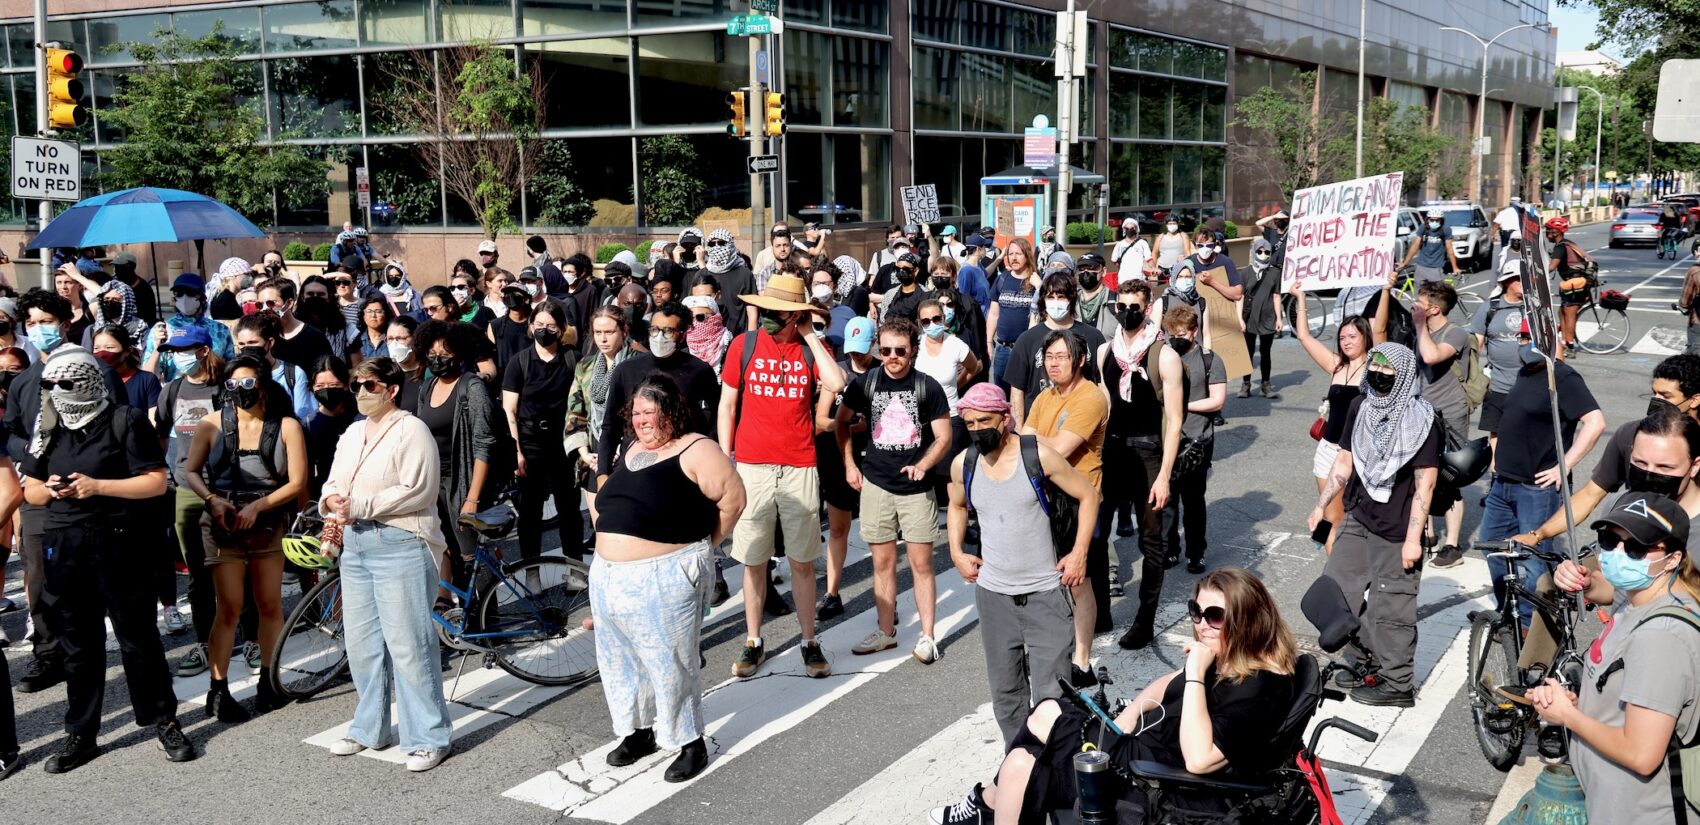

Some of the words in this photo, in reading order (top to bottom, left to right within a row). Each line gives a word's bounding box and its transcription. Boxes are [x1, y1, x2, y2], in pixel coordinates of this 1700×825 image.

[752, 0, 770, 10] ARCH
[746, 24, 768, 33] STREET
[36, 145, 58, 158] NO
[25, 160, 69, 175] TURN
[757, 160, 766, 168] ONE
[18, 176, 39, 189] ON
[45, 178, 76, 191] RED
[904, 185, 934, 199] END
[1292, 173, 1401, 219] IMMIGRANTS
[906, 198, 936, 211] ICE
[909, 209, 940, 225] RAIDS
[1286, 216, 1346, 253] SIGNED
[1351, 212, 1391, 238] THE
[1283, 246, 1395, 282] DECLARATION
[754, 358, 803, 373] STOP
[749, 371, 808, 385] ARMING
[749, 383, 805, 398] ISRAEL
